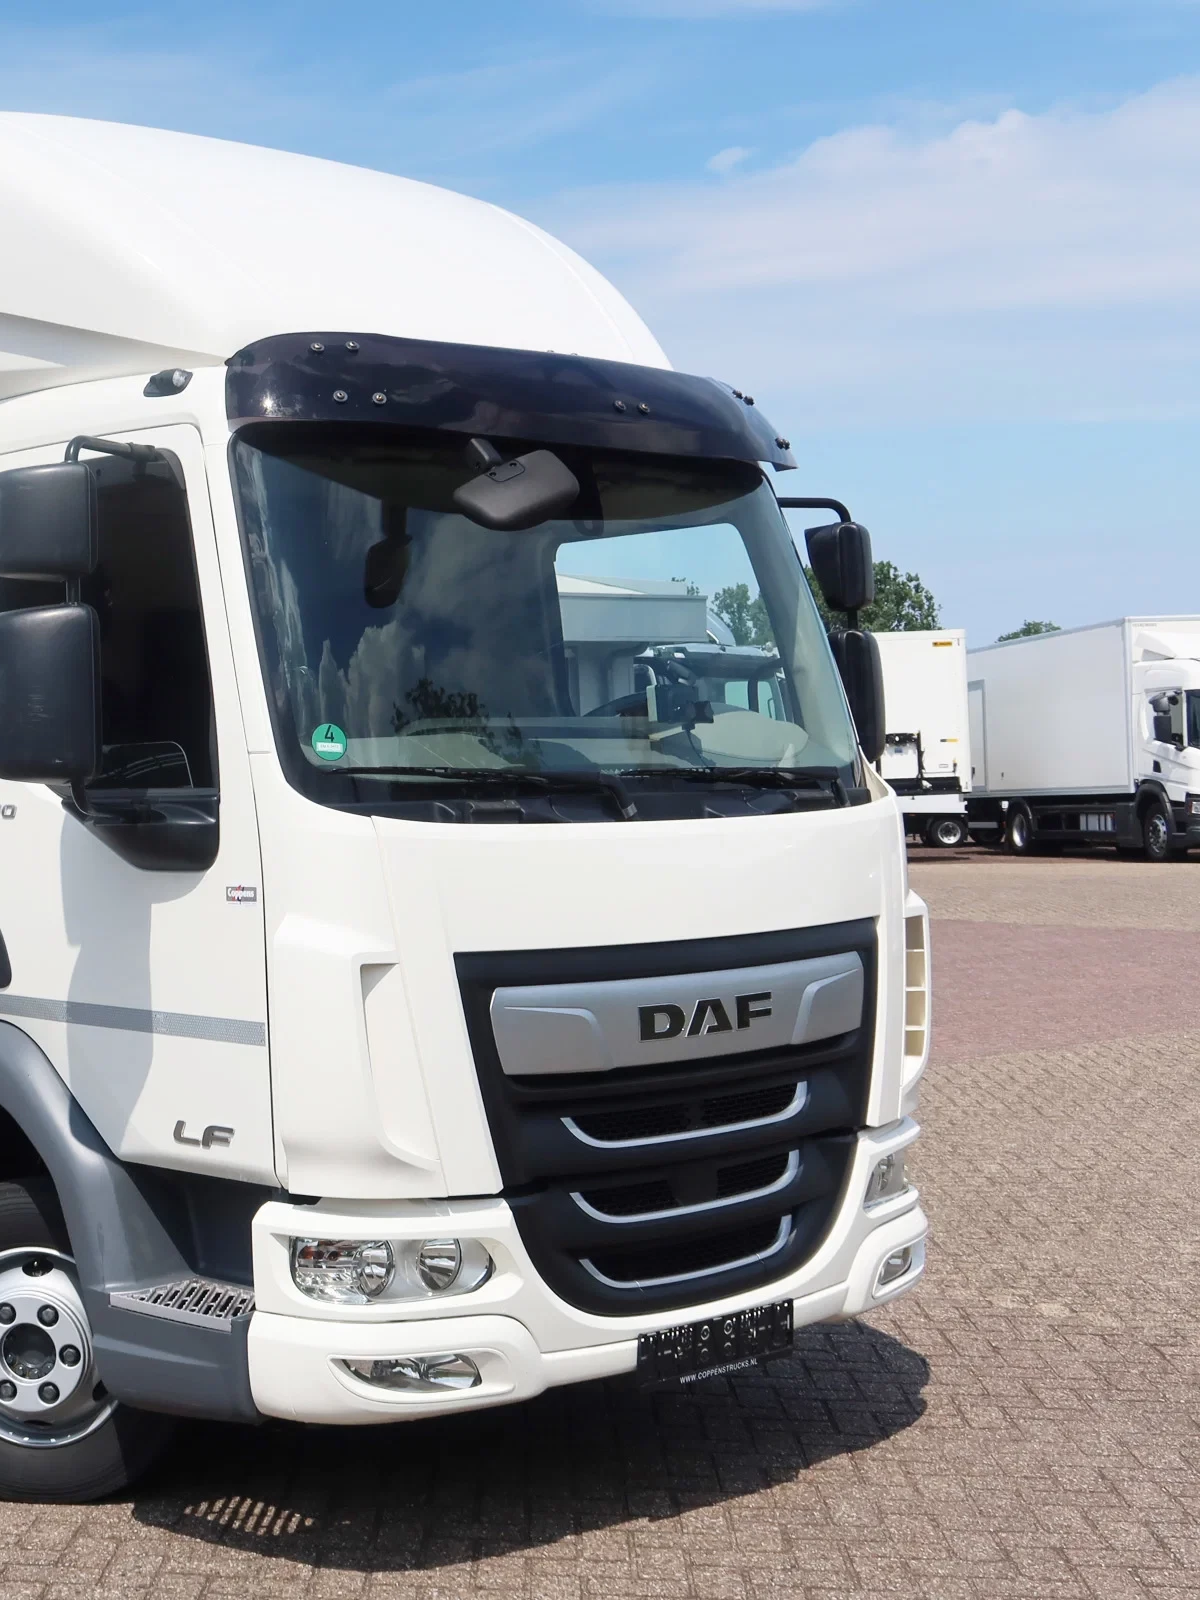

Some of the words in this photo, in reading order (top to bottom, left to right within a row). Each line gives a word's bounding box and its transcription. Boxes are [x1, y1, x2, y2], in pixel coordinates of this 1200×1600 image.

[324, 724, 335, 743] 4
[227, 887, 255, 901] Coppens
[638, 991, 773, 1043] DAF
[173, 1120, 235, 1150] LF
[679, 1357, 758, 1385] WWW.COPPENSTRUCKS.NL
